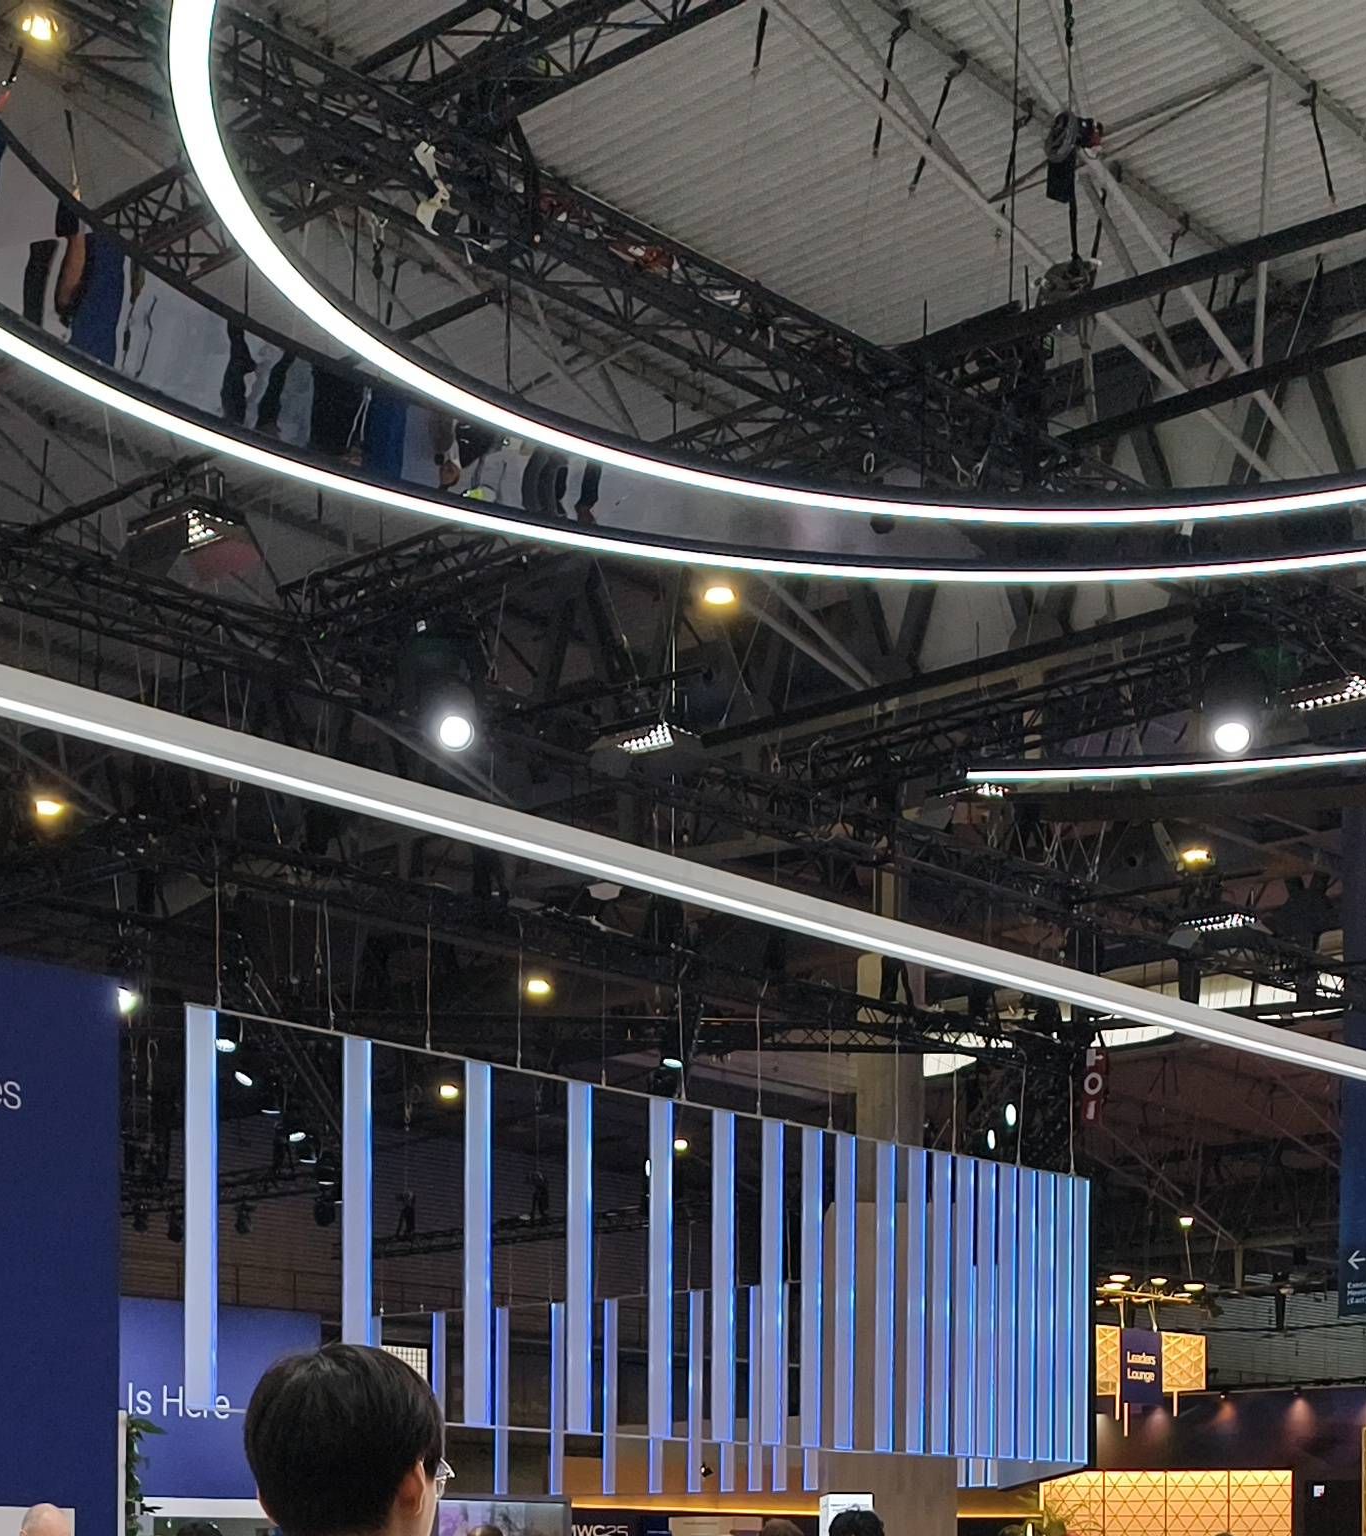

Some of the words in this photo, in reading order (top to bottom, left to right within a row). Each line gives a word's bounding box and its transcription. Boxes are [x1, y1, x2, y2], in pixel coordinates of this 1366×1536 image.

[1126, 1351, 1156, 1366] Leaders
[1126, 1367, 1156, 1383] Lounge
[128, 1382, 152, 1416] Is
[162, 1384, 231, 1419] He
